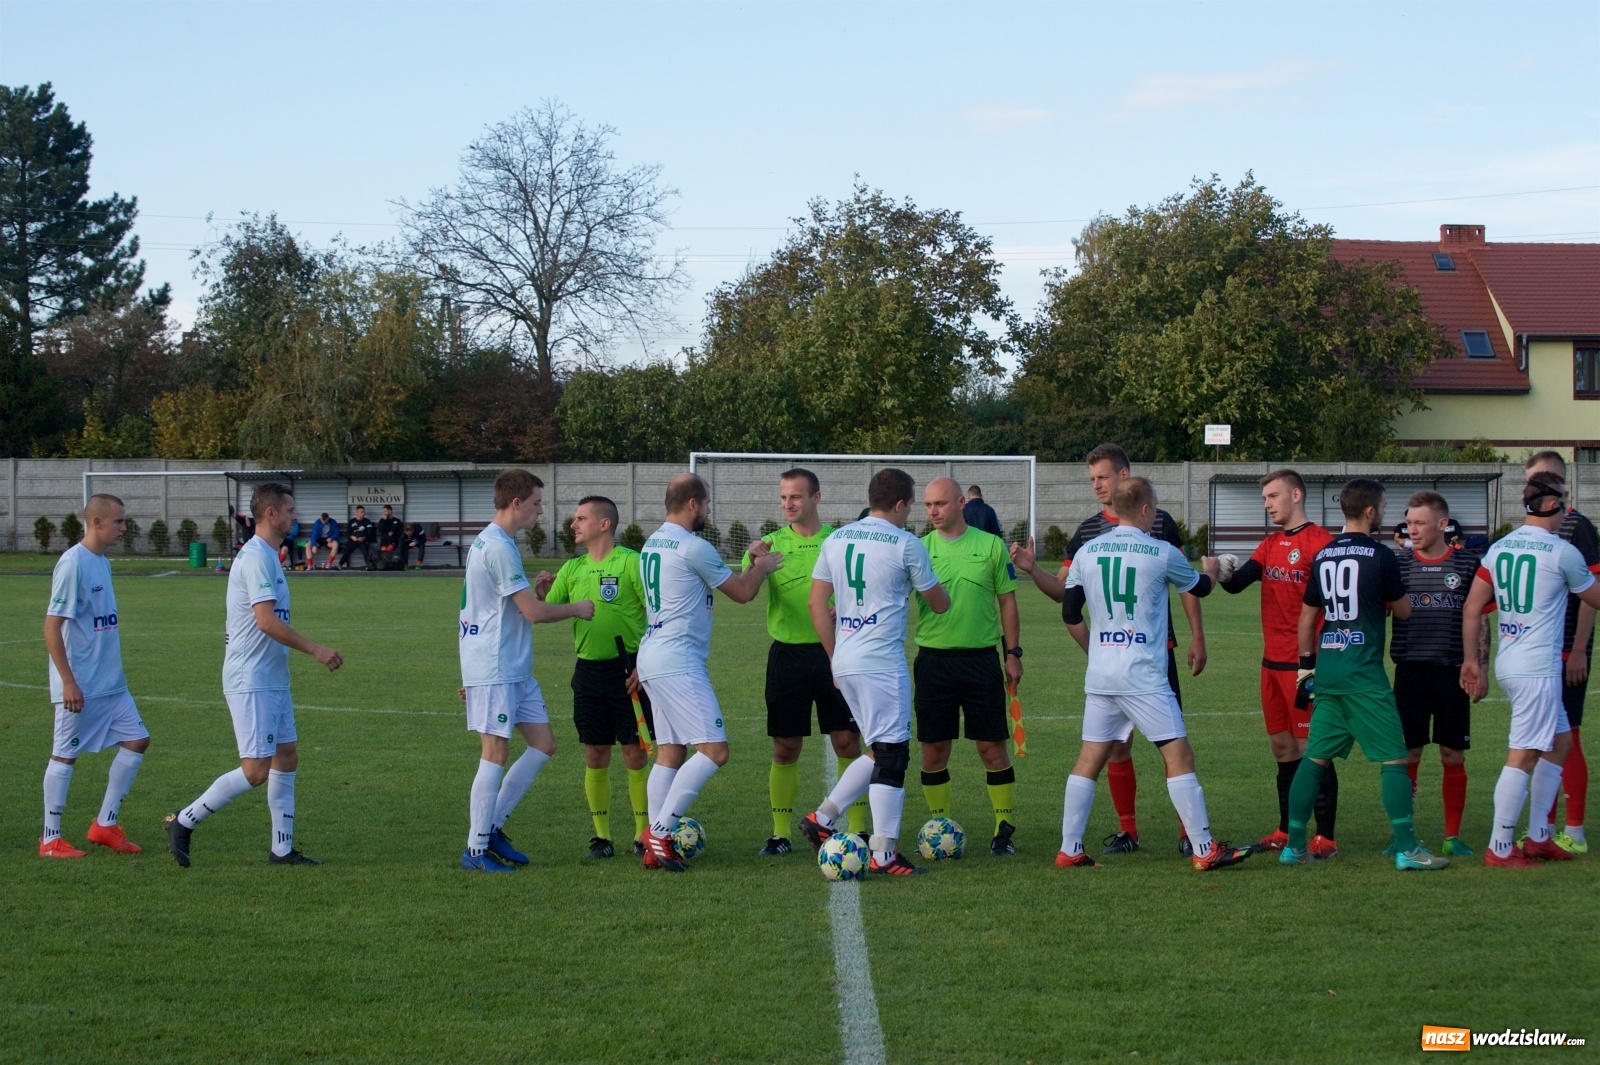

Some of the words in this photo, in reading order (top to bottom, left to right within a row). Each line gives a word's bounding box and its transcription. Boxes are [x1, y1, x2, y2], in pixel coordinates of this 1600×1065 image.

[350, 493, 403, 503] TWORKÓW
[367, 486, 386, 495] LKS
[843, 529, 869, 540] POLONIA
[1087, 543, 1099, 554] LKS
[1099, 542, 1129, 553] POLONIA
[1129, 543, 1160, 557] ŁAZISKA
[641, 551, 661, 613] 19
[845, 543, 866, 606] 4
[1264, 564, 1304, 584] ROSAT
[1496, 552, 1537, 614] 90
[1097, 556, 1138, 620] 14
[1320, 559, 1359, 621] 99
[1408, 592, 1465, 608] ROSAT
[840, 613, 878, 632] moya
[1099, 627, 1147, 649] moya
[1322, 627, 1365, 651] moya
